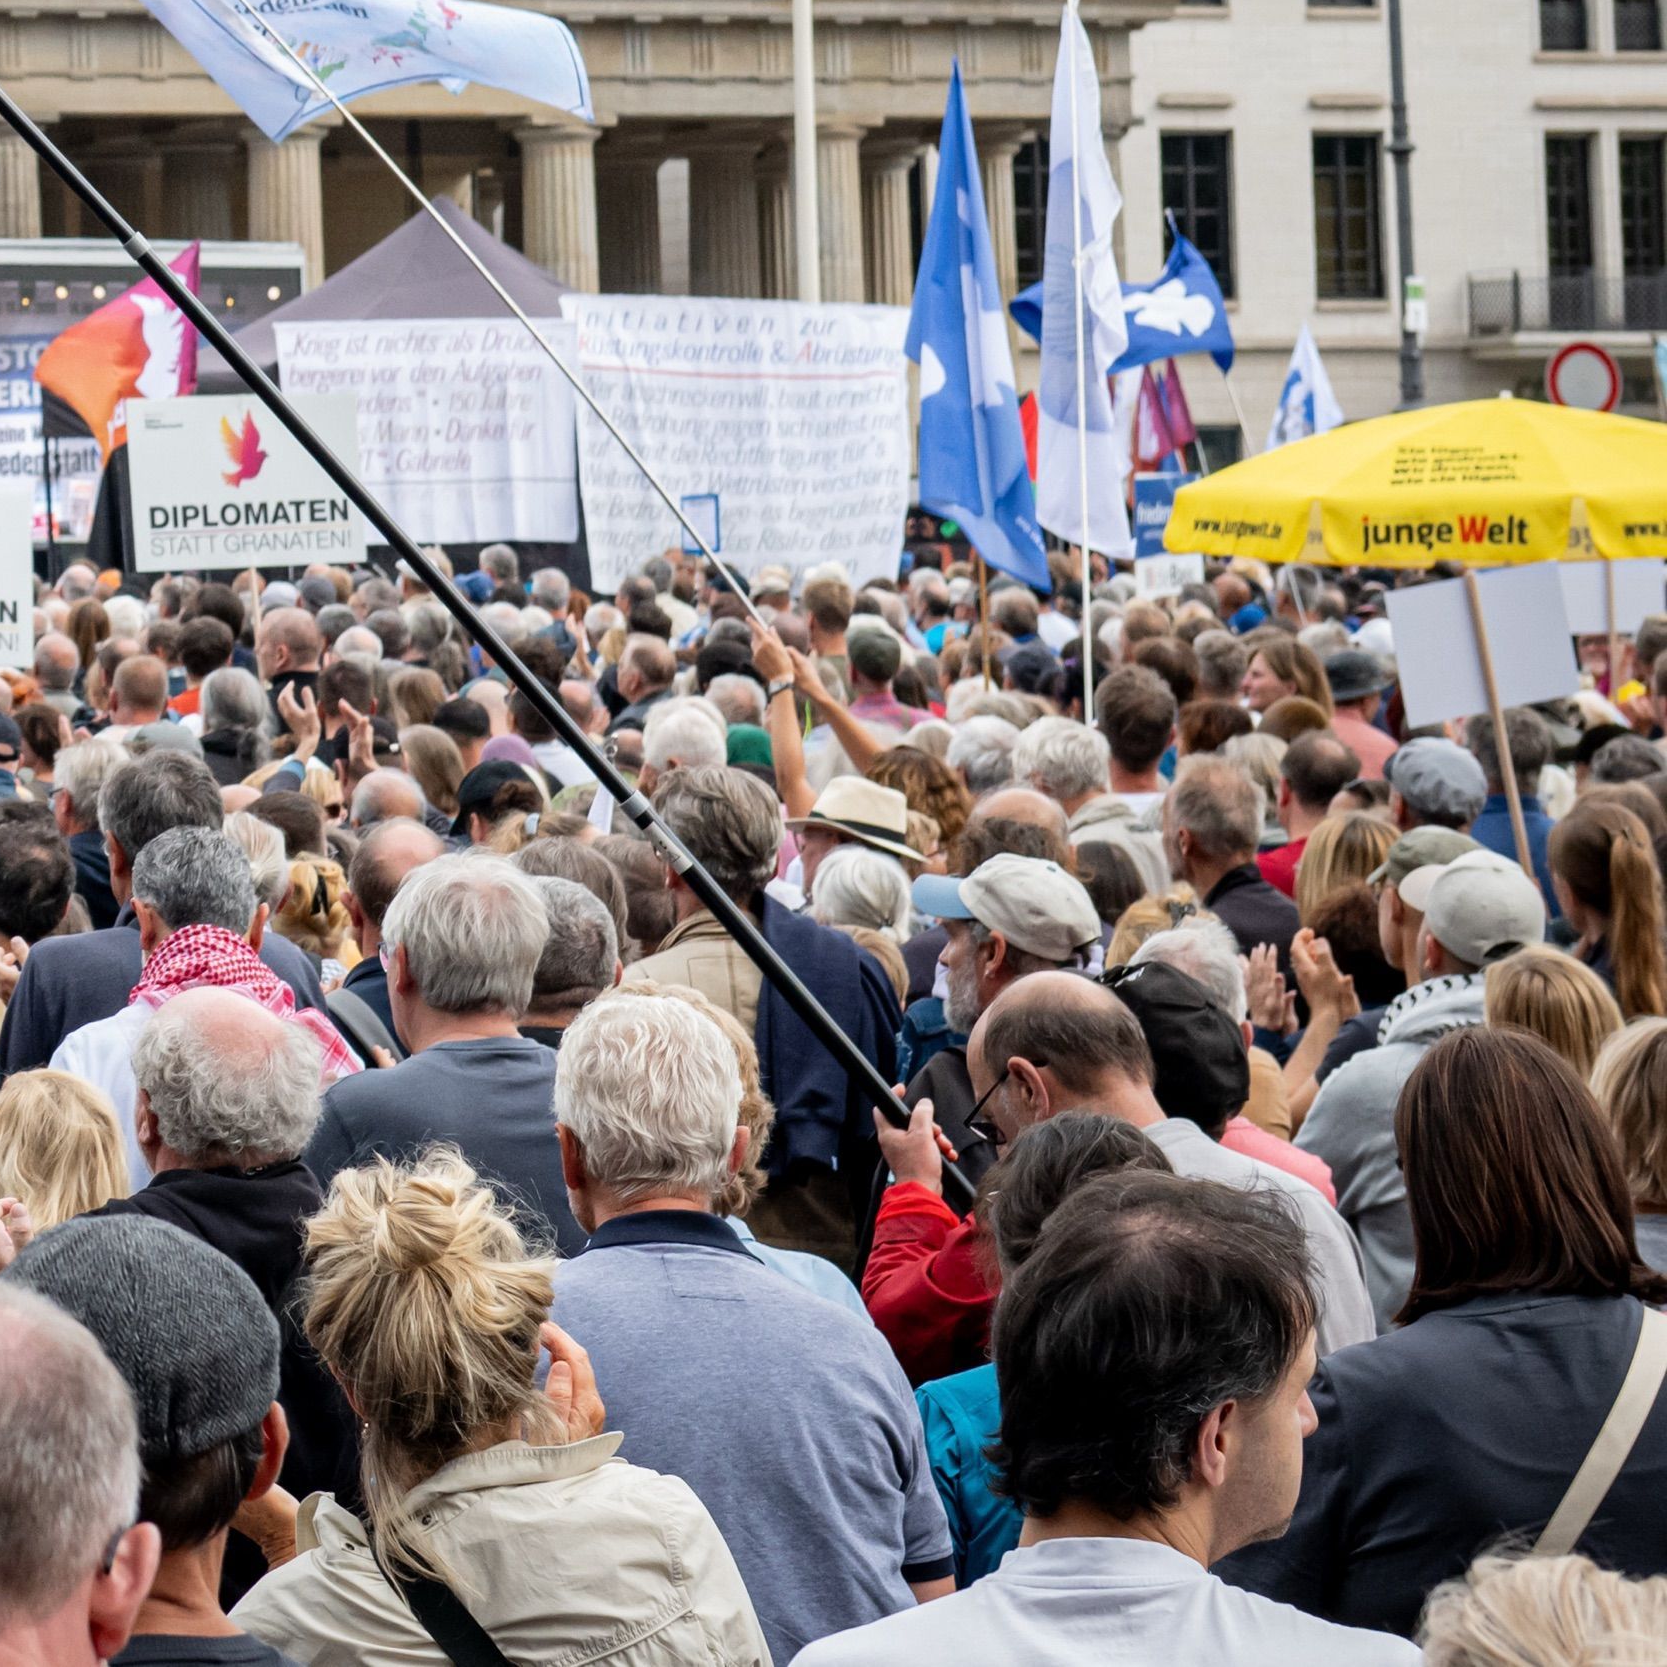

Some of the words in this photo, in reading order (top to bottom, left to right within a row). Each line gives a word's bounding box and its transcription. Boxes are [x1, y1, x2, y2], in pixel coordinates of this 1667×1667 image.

[344, 333, 368, 354] ist
[375, 327, 442, 354] nichts
[446, 327, 473, 354] als
[409, 361, 446, 384] den
[148, 499, 349, 530] DIPLOMATEN
[149, 534, 216, 558] STATT
[222, 529, 352, 555] GRANATEN!
[1362, 513, 1454, 553] junge
[1458, 513, 1529, 545] Welt
